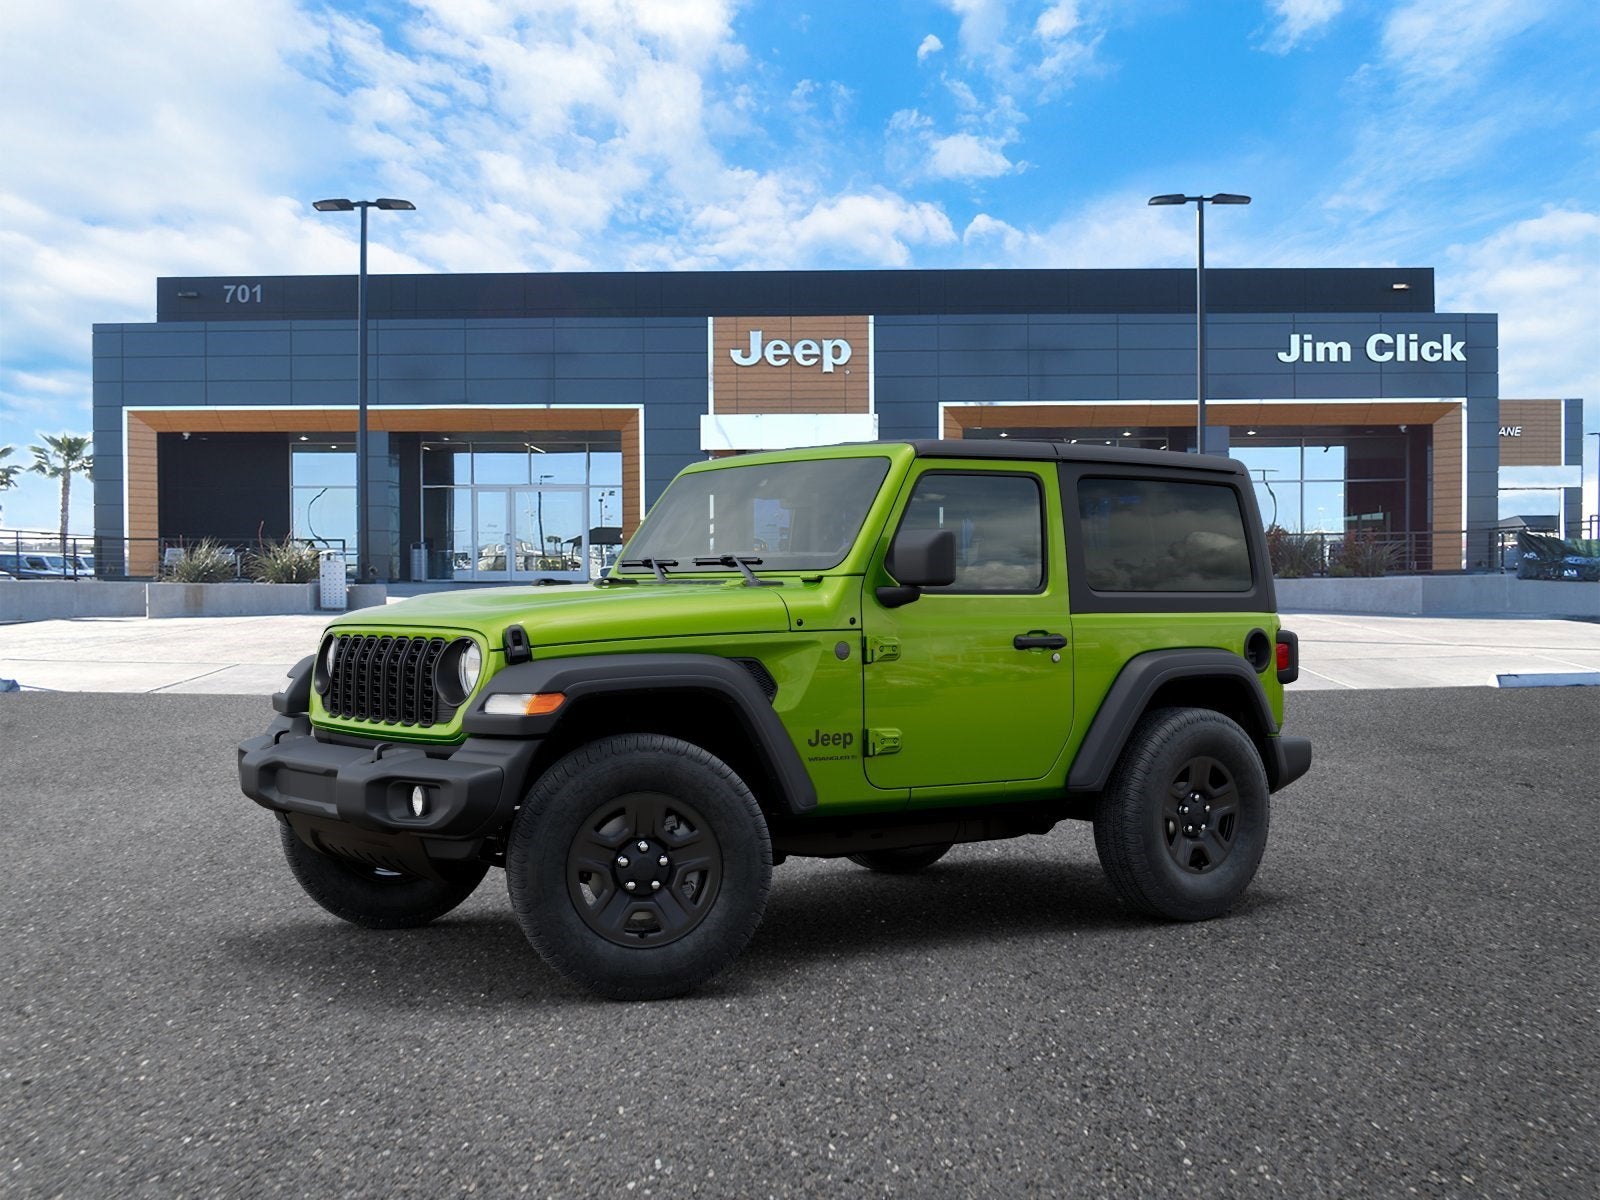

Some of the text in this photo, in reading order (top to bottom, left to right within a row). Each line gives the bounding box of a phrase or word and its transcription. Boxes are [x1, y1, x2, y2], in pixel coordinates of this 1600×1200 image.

[223, 284, 262, 304] 701
[729, 330, 852, 373] Jeep
[1277, 333, 1467, 363] Jim Click
[807, 729, 854, 749] Jeep
